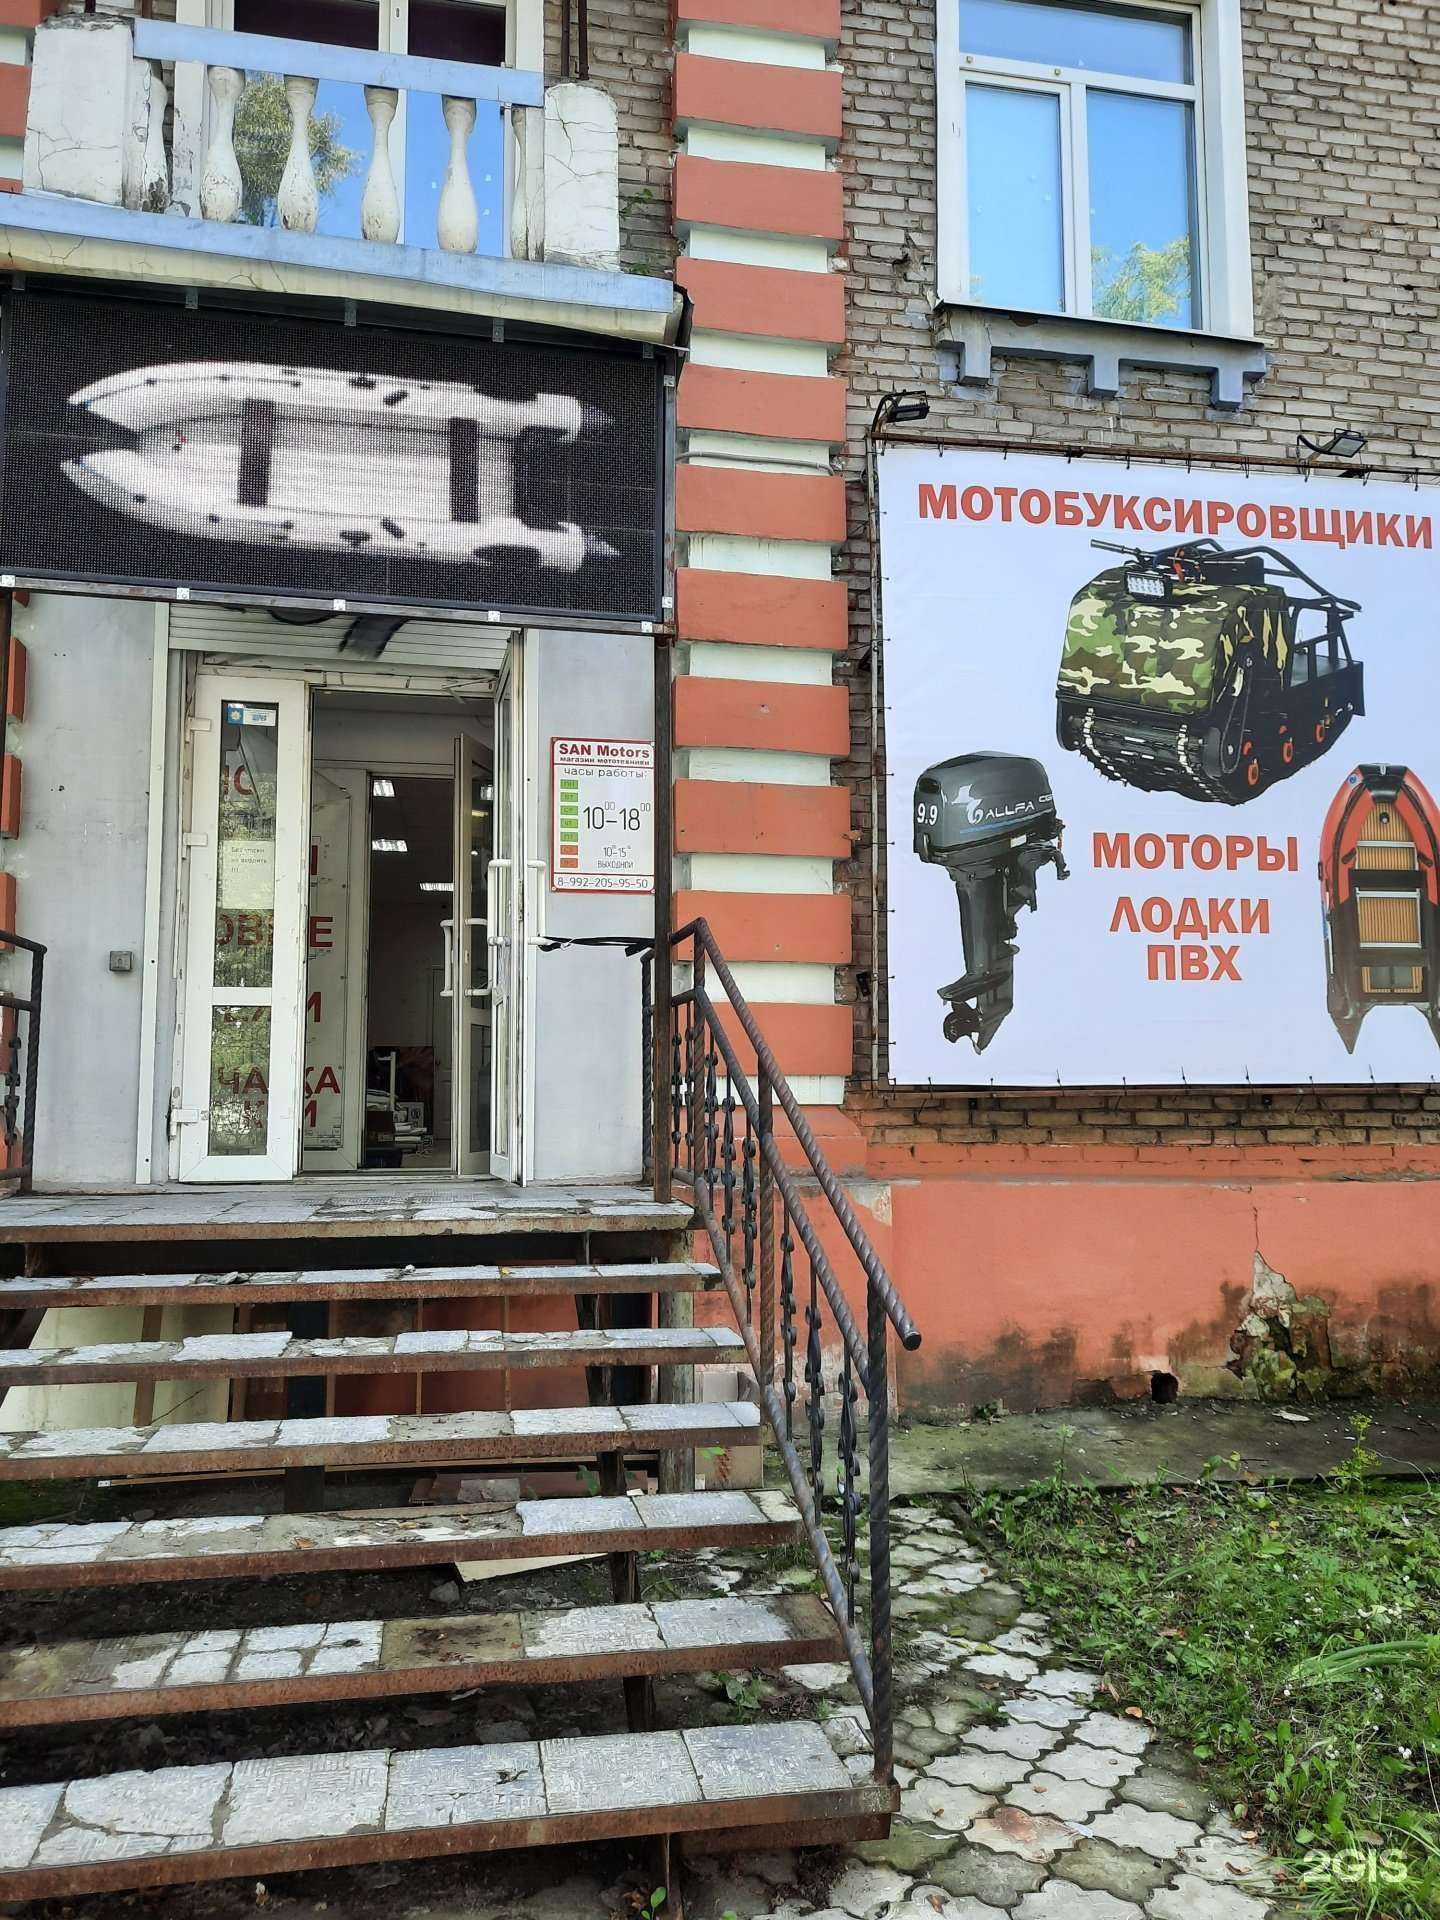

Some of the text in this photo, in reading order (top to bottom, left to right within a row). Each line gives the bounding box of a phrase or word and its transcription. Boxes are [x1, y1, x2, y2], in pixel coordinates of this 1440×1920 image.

[918, 483, 1433, 549] МОТОБУКСИРОВЩИКИ
[560, 743, 650, 759] SAN Motors
[564, 767, 594, 776] часы
[916, 802, 939, 826] 9.9
[985, 800, 1036, 820] ALLFA
[1092, 832, 1299, 872] МОТОРЫ
[557, 877, 649, 889] 8-992-205-95-50
[1109, 896, 1271, 941] ЛОДКИ
[1147, 944, 1243, 981] ПВХ
